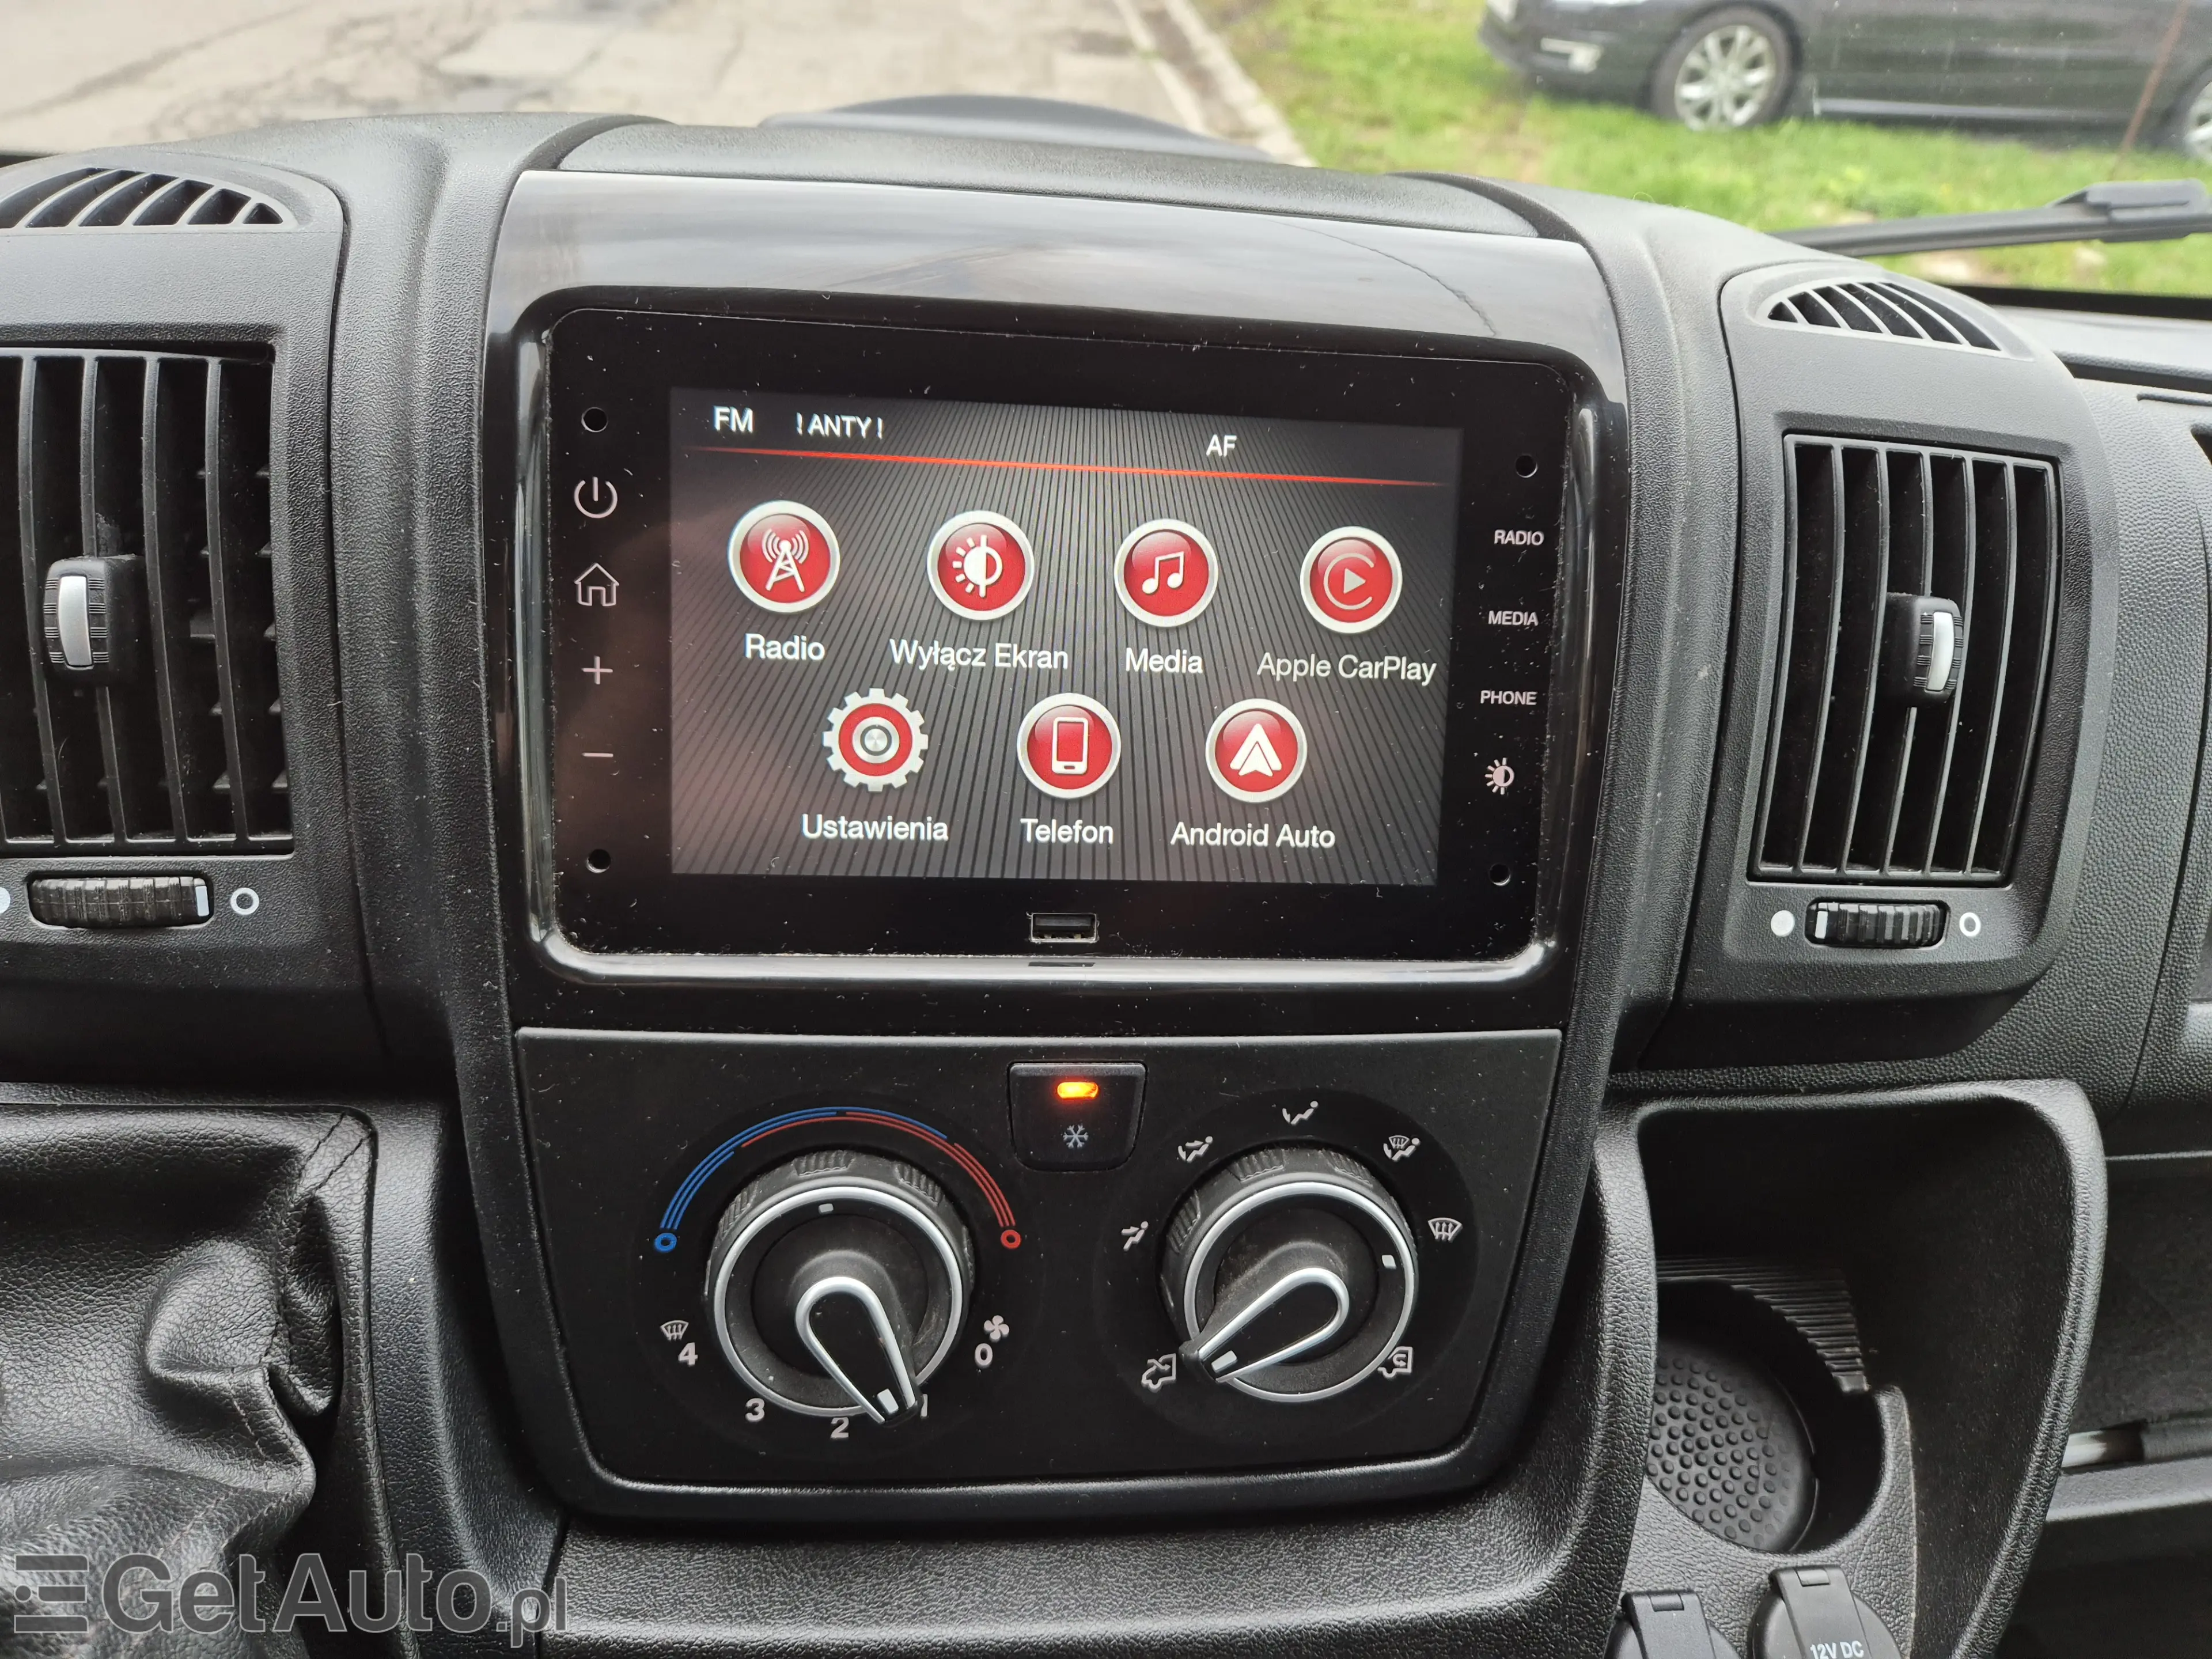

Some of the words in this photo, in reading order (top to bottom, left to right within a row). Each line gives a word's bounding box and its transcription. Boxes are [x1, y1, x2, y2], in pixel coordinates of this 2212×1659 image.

[714, 406, 754, 433] FM
[1206, 434, 1237, 457] AF
[1494, 530, 1544, 546] RADIO
[1488, 611, 1539, 626] MEDIA
[743, 632, 825, 662] Radio
[889, 638, 986, 671] Wyłącz
[994, 642, 1069, 670] Ekran
[1124, 647, 1203, 675] Media
[1257, 652, 1331, 681] Apple
[1338, 655, 1438, 687] CarPlay
[1480, 690, 1537, 707] PHONE
[801, 813, 949, 843] Ustawienia
[1020, 817, 1114, 845] Telefon
[1170, 823, 1268, 848] Android
[1274, 824, 1336, 849] Auto
[678, 1342, 698, 1366] 4
[975, 1343, 993, 1368] 0
[745, 1397, 766, 1423] 3
[830, 1416, 849, 1439] 2
[1810, 1642, 1837, 1659] 12V
[1839, 1640, 1865, 1658] DC
